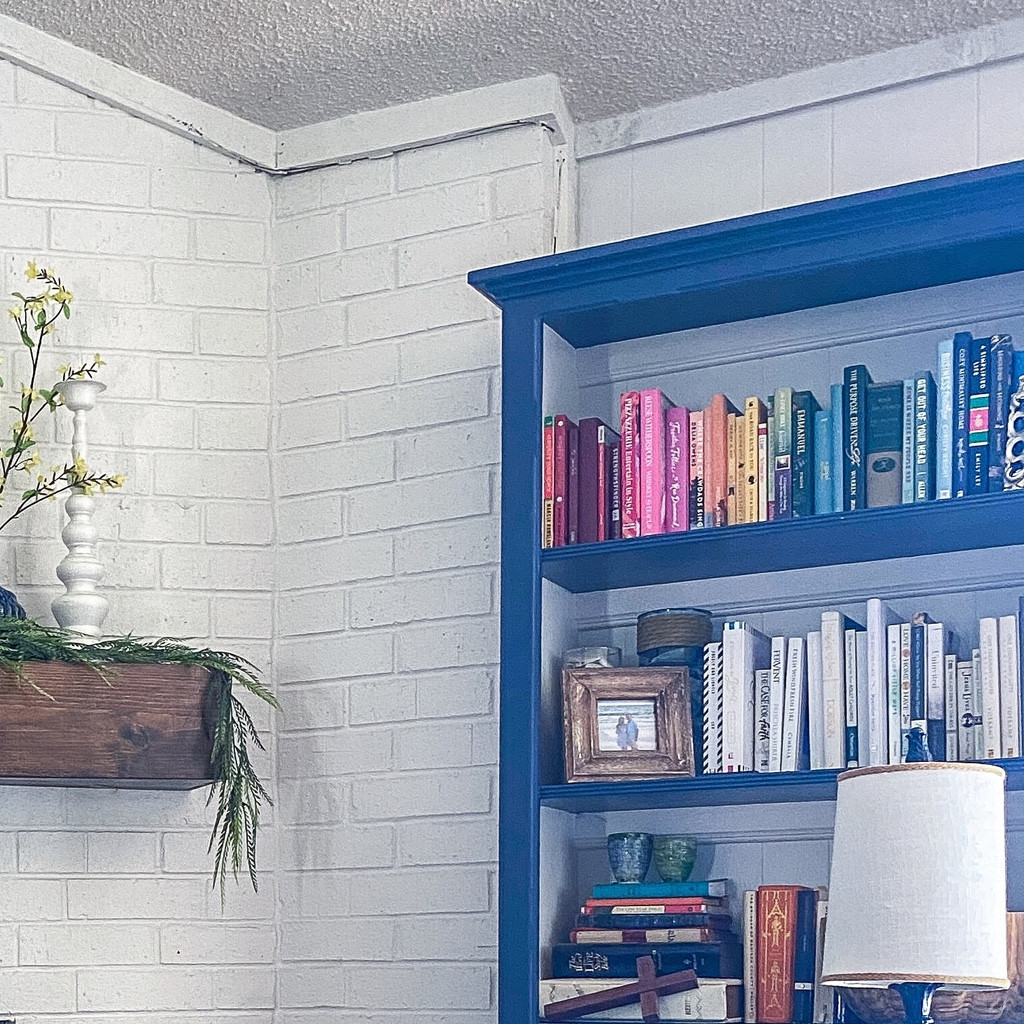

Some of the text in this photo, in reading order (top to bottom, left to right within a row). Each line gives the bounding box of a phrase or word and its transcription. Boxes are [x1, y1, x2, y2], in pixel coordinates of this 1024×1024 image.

[940, 352, 951, 390] BUSINESS
[958, 348, 966, 366] COZY
[850, 383, 858, 416] PURPOSE
[958, 368, 966, 408] MINIMALIST
[796, 410, 806, 455] EMMANUEL
[850, 416, 858, 446] DRIVEN
[917, 378, 926, 464] GET OUT OF YOUR HEAD
[624, 451, 632, 486] Entertain
[624, 496, 633, 514] Style
[918, 480, 926, 498] ALLEN
[931, 650, 940, 688] Uninvited
[760, 686, 770, 704] CASE
[760, 705, 768, 718] FOR
